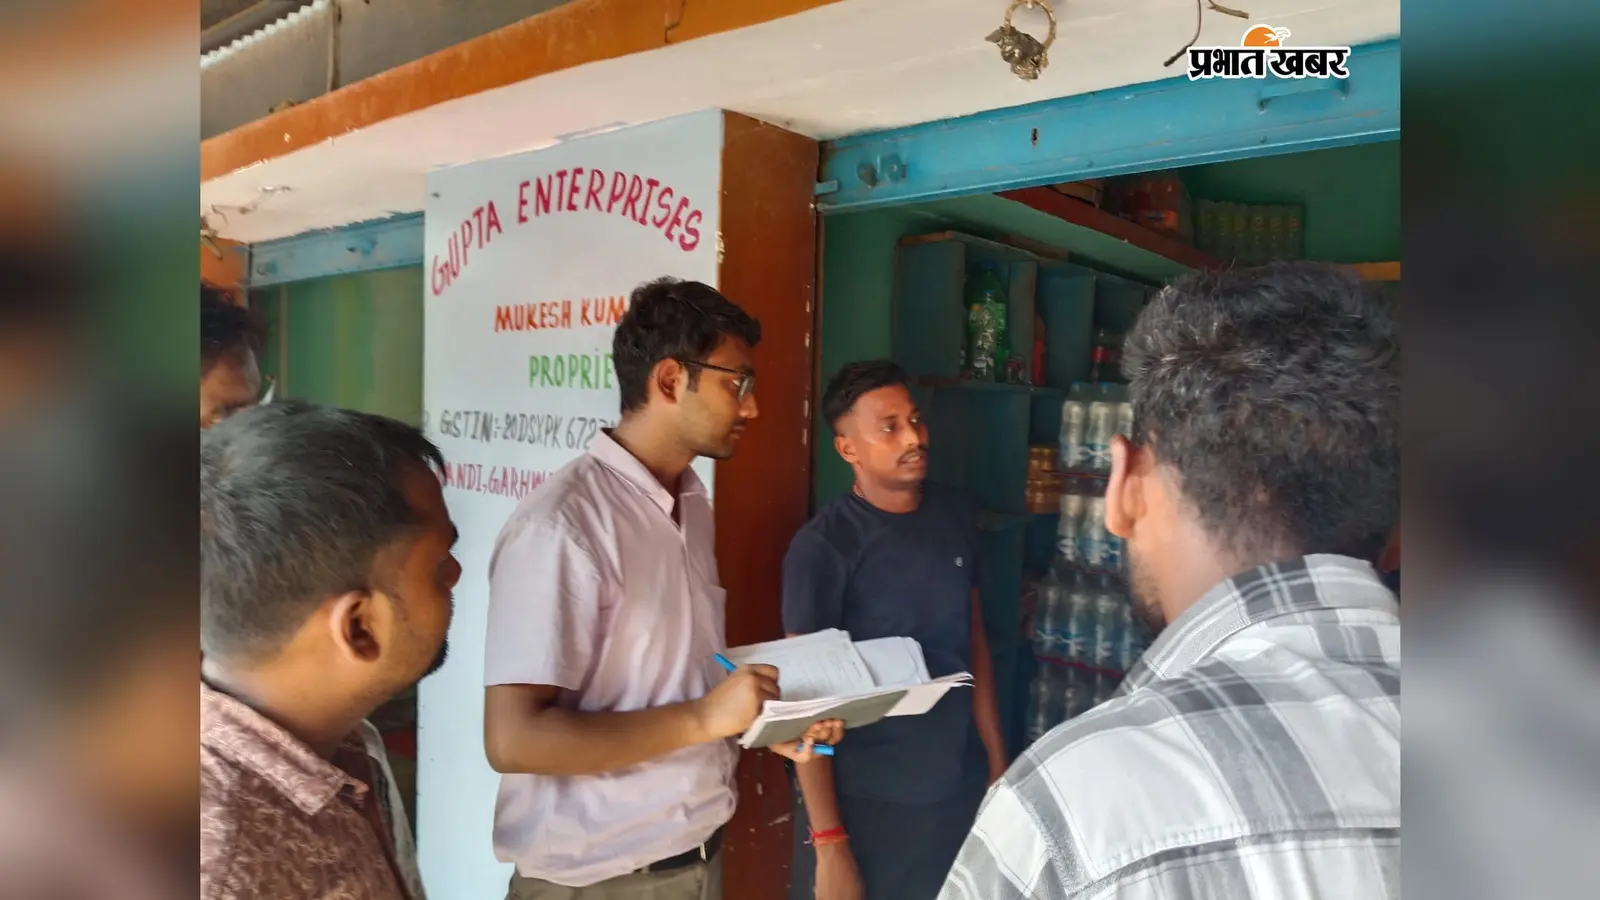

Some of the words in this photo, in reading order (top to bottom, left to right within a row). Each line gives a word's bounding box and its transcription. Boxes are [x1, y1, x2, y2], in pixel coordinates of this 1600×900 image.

[430, 199, 503, 296] GUPTA
[517, 166, 703, 252] ENTERPRISES
[494, 299, 572, 333] MUKESH
